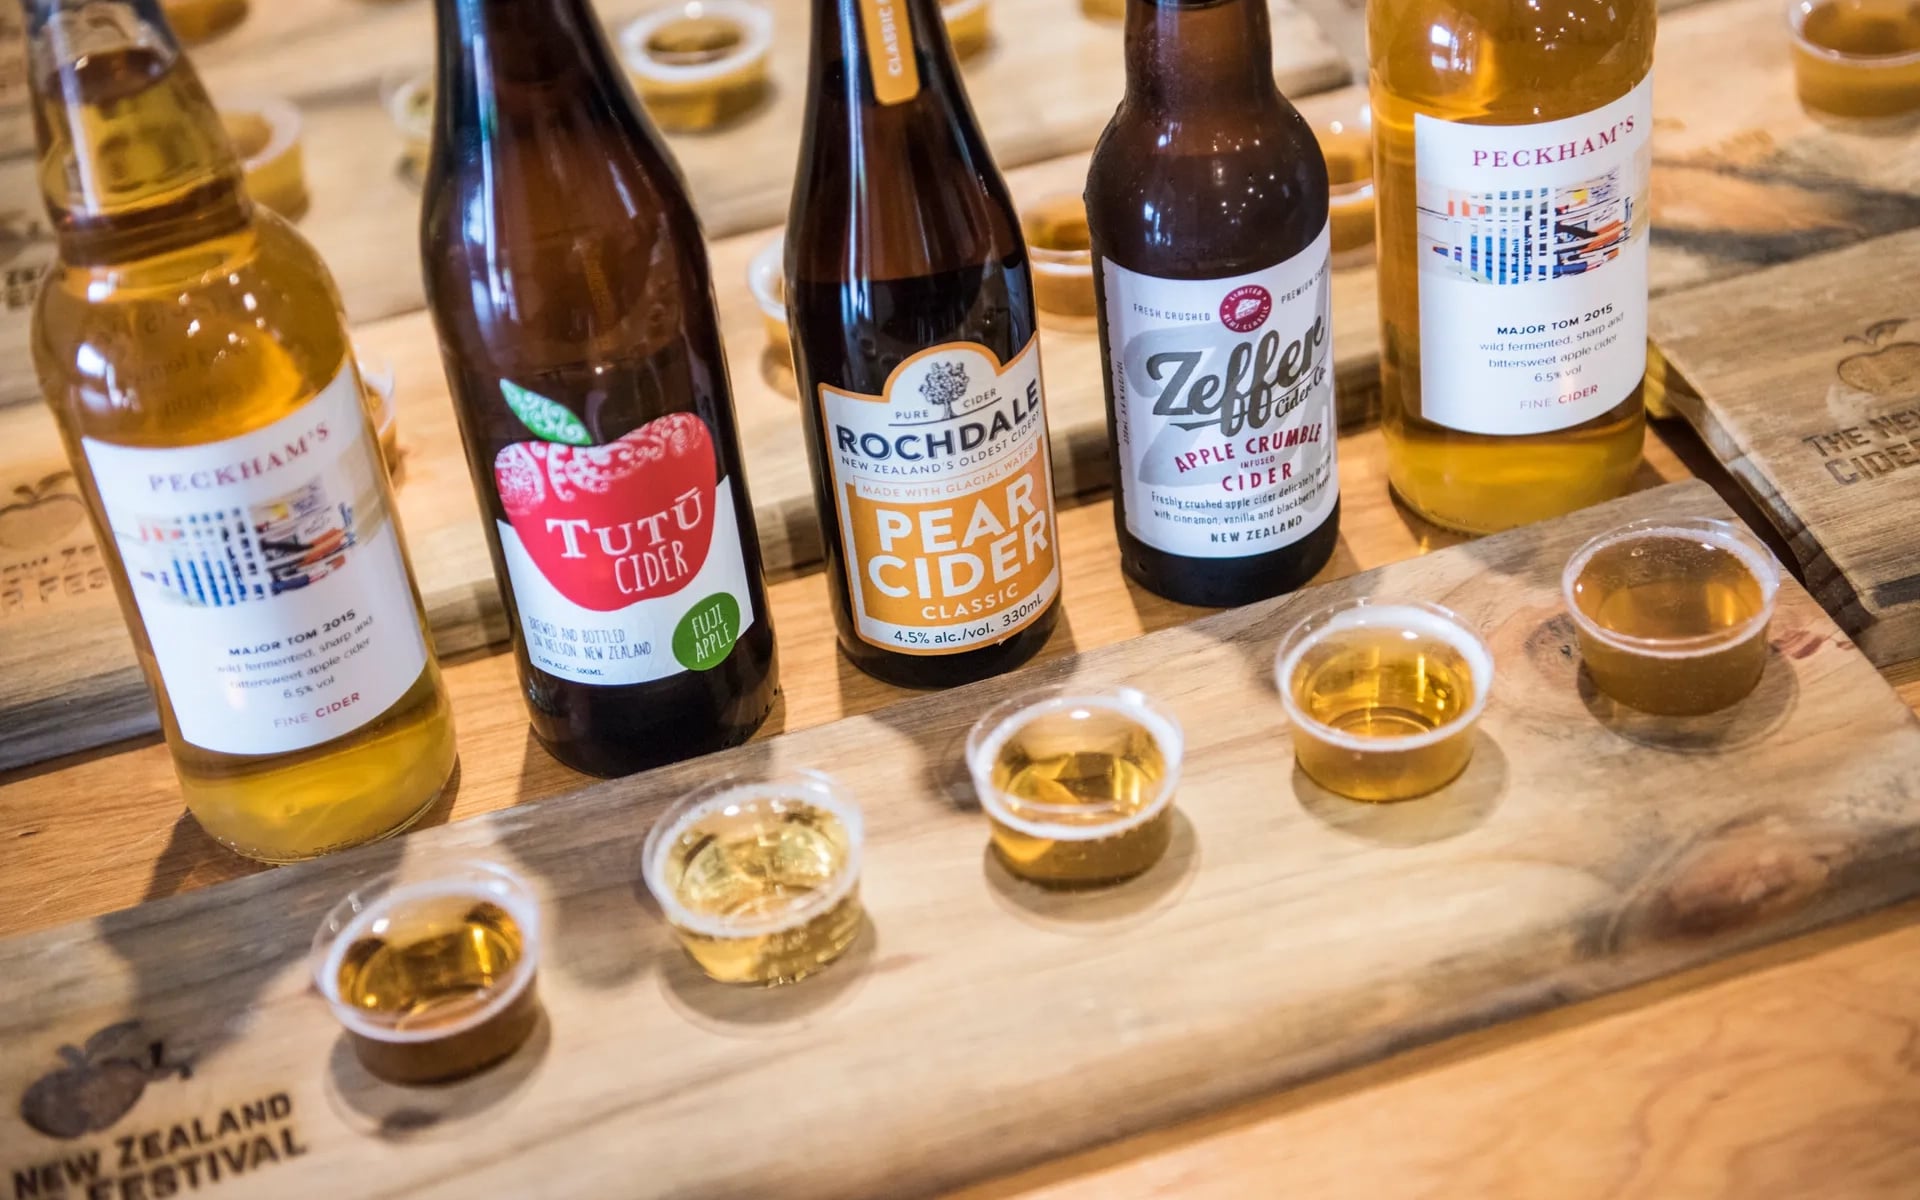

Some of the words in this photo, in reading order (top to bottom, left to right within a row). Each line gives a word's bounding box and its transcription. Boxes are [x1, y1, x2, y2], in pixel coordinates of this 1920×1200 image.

[878, 6, 902, 76] CLASSIC
[1473, 115, 1635, 167] PECKHAM'S
[1229, 287, 1263, 302] LIMITED
[1281, 277, 1313, 304] PREMIUM
[1134, 302, 1161, 319] FRESH
[1165, 311, 1211, 322] CRUSHED
[1497, 324, 1546, 335] MAJOR
[1551, 317, 1580, 331] TOM
[1584, 303, 1613, 322] 2015
[1480, 342, 1504, 351] wild
[1577, 324, 1605, 343] sharp
[1607, 312, 1625, 328] and
[1489, 355, 1556, 368] bittersweet
[1560, 346, 1592, 363] apple
[1594, 334, 1618, 351] cider
[1146, 315, 1324, 437] Zeffer
[1534, 371, 1562, 383] 6.5%
[1565, 365, 1582, 377] vol
[895, 409, 929, 420] PURE
[963, 388, 997, 408] CIDER
[1275, 383, 1312, 418] Cider
[1520, 399, 1551, 410] FINE
[1558, 384, 1599, 405] CIDER
[836, 378, 1040, 461] ROCHDALE
[148, 421, 331, 492] PECKHAM'S
[841, 456, 869, 471] NEW
[874, 457, 954, 475] ZEALAND'S
[959, 440, 1008, 466] OLDEST
[1011, 410, 1041, 444] CIDERY
[1174, 443, 1235, 474] APPLE
[1245, 423, 1322, 455] CRUMBLE
[1803, 427, 1871, 457] THE
[862, 484, 901, 497] MADE
[905, 487, 941, 497] WITH
[946, 469, 1000, 494] GLACIAL
[1004, 442, 1035, 471] WATER
[1222, 462, 1292, 492] CIDER
[1241, 455, 1276, 469] INFUSED
[1151, 491, 1182, 510] Freshly
[1185, 499, 1223, 510] crushed
[1225, 499, 1250, 511] apple
[1254, 491, 1276, 506] cider
[1279, 472, 1314, 498] delicately
[1154, 510, 1171, 521] with
[1224, 512, 1255, 524] vanilla
[1258, 507, 1274, 520] and
[1277, 488, 1316, 515] blackberry
[876, 472, 1037, 554] PEAR
[1211, 531, 1240, 543] NEW
[1246, 515, 1303, 541] ZEALAND
[614, 540, 689, 595] CIDER
[868, 510, 1048, 599] CIDER
[893, 630, 930, 645] 4.5%
[934, 622, 995, 644] alc./vol.
[1002, 593, 1044, 627] 330mL
[921, 583, 1019, 620] CLASSIC
[228, 640, 282, 657] MAJOR
[286, 628, 318, 646] TOM
[322, 608, 357, 633] 2015
[528, 615, 557, 638] BREWED
[561, 627, 578, 642] AND
[582, 628, 626, 644] BOTTLED
[691, 603, 724, 639] FUJI
[216, 663, 242, 673] wild
[319, 631, 352, 655] sharp
[354, 615, 374, 635] and
[584, 646, 604, 661] NEW
[608, 641, 652, 661] ZEALAND
[695, 622, 733, 663] APPLE
[229, 670, 303, 690] bittersweet
[306, 655, 341, 676] apple
[343, 637, 371, 660] cider
[283, 685, 314, 699] 6.5%
[317, 675, 335, 690] vol
[274, 712, 310, 729] FINE
[315, 692, 361, 718] CIDER
[13, 1150, 99, 1200] NEW
[114, 1093, 293, 1171] ZEALAND
[84, 1127, 308, 1200] FESTIVAL
